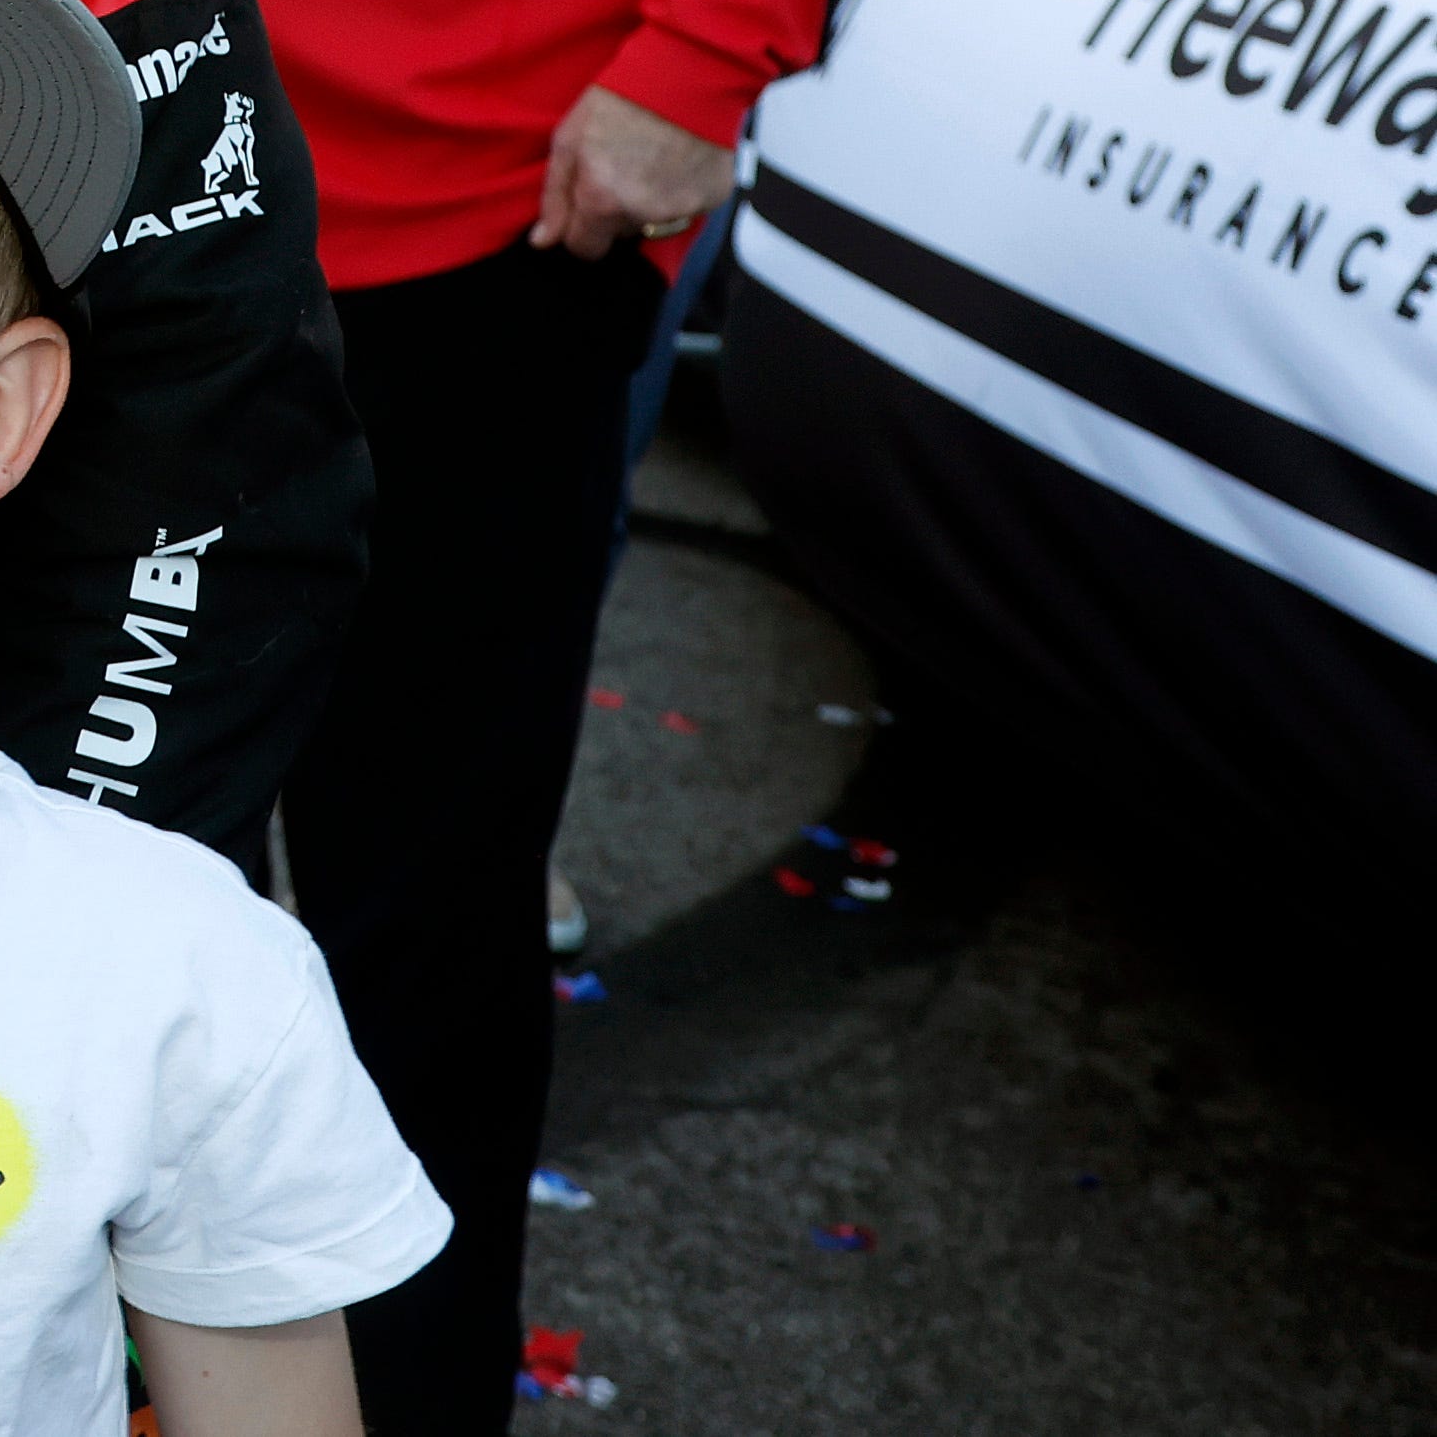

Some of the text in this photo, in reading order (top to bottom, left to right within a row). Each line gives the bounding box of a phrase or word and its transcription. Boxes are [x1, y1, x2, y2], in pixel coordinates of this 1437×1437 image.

[102, 189, 264, 252] ACK
[1018, 104, 1437, 320] INSURANCE
[66, 525, 224, 806] HUMBA
